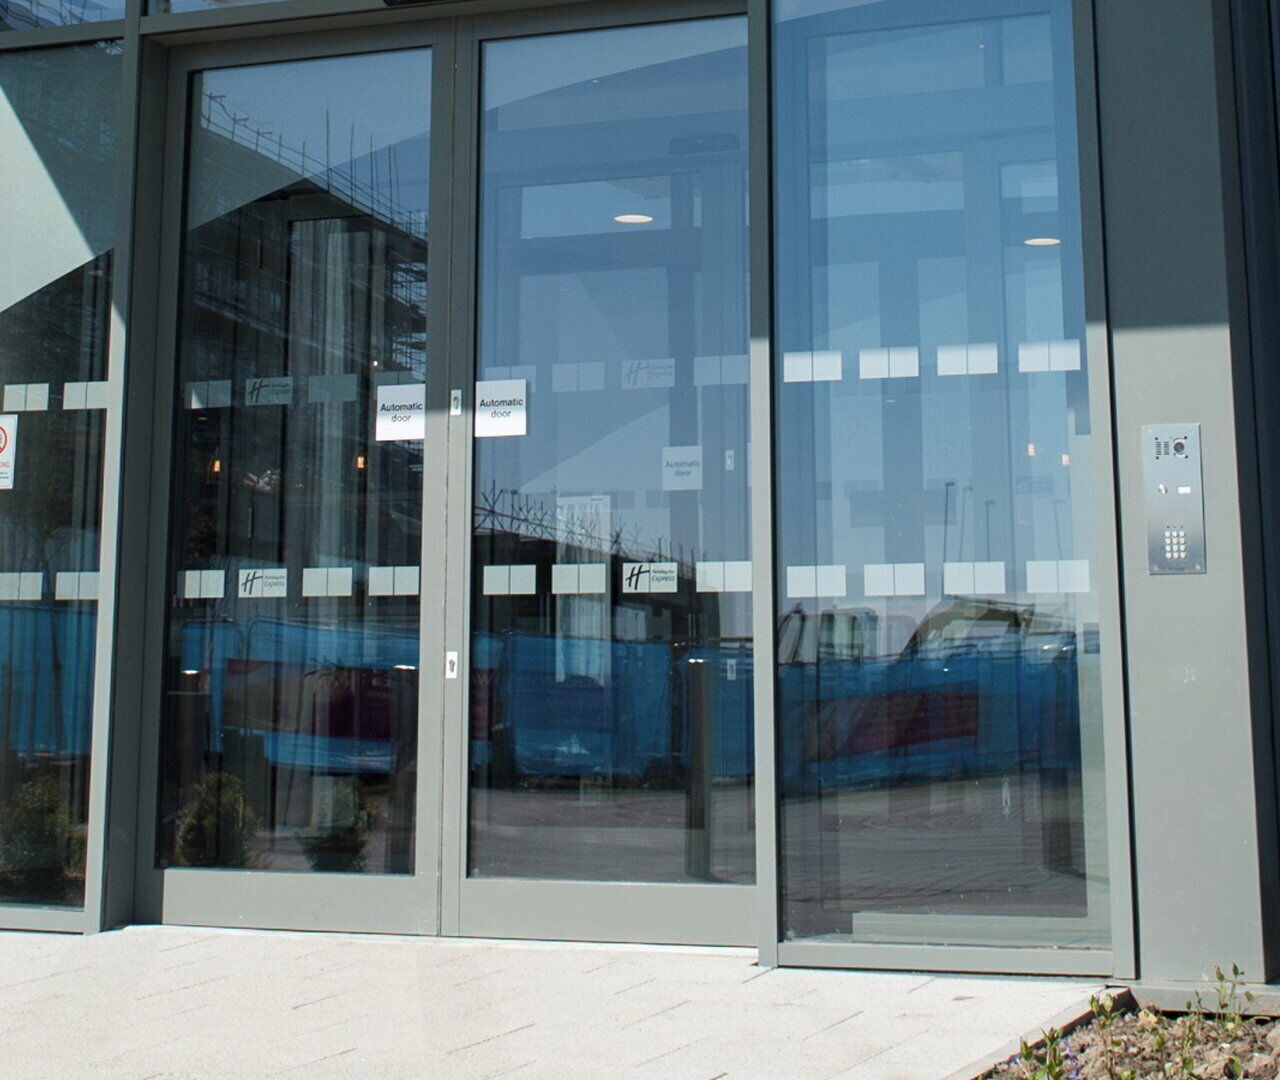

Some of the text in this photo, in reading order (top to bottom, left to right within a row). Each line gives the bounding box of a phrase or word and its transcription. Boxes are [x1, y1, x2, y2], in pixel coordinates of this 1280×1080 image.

[380, 401, 423, 412] Automatic
[480, 397, 523, 408] Automatic
[391, 413, 411, 422] door
[491, 409, 512, 418] door
